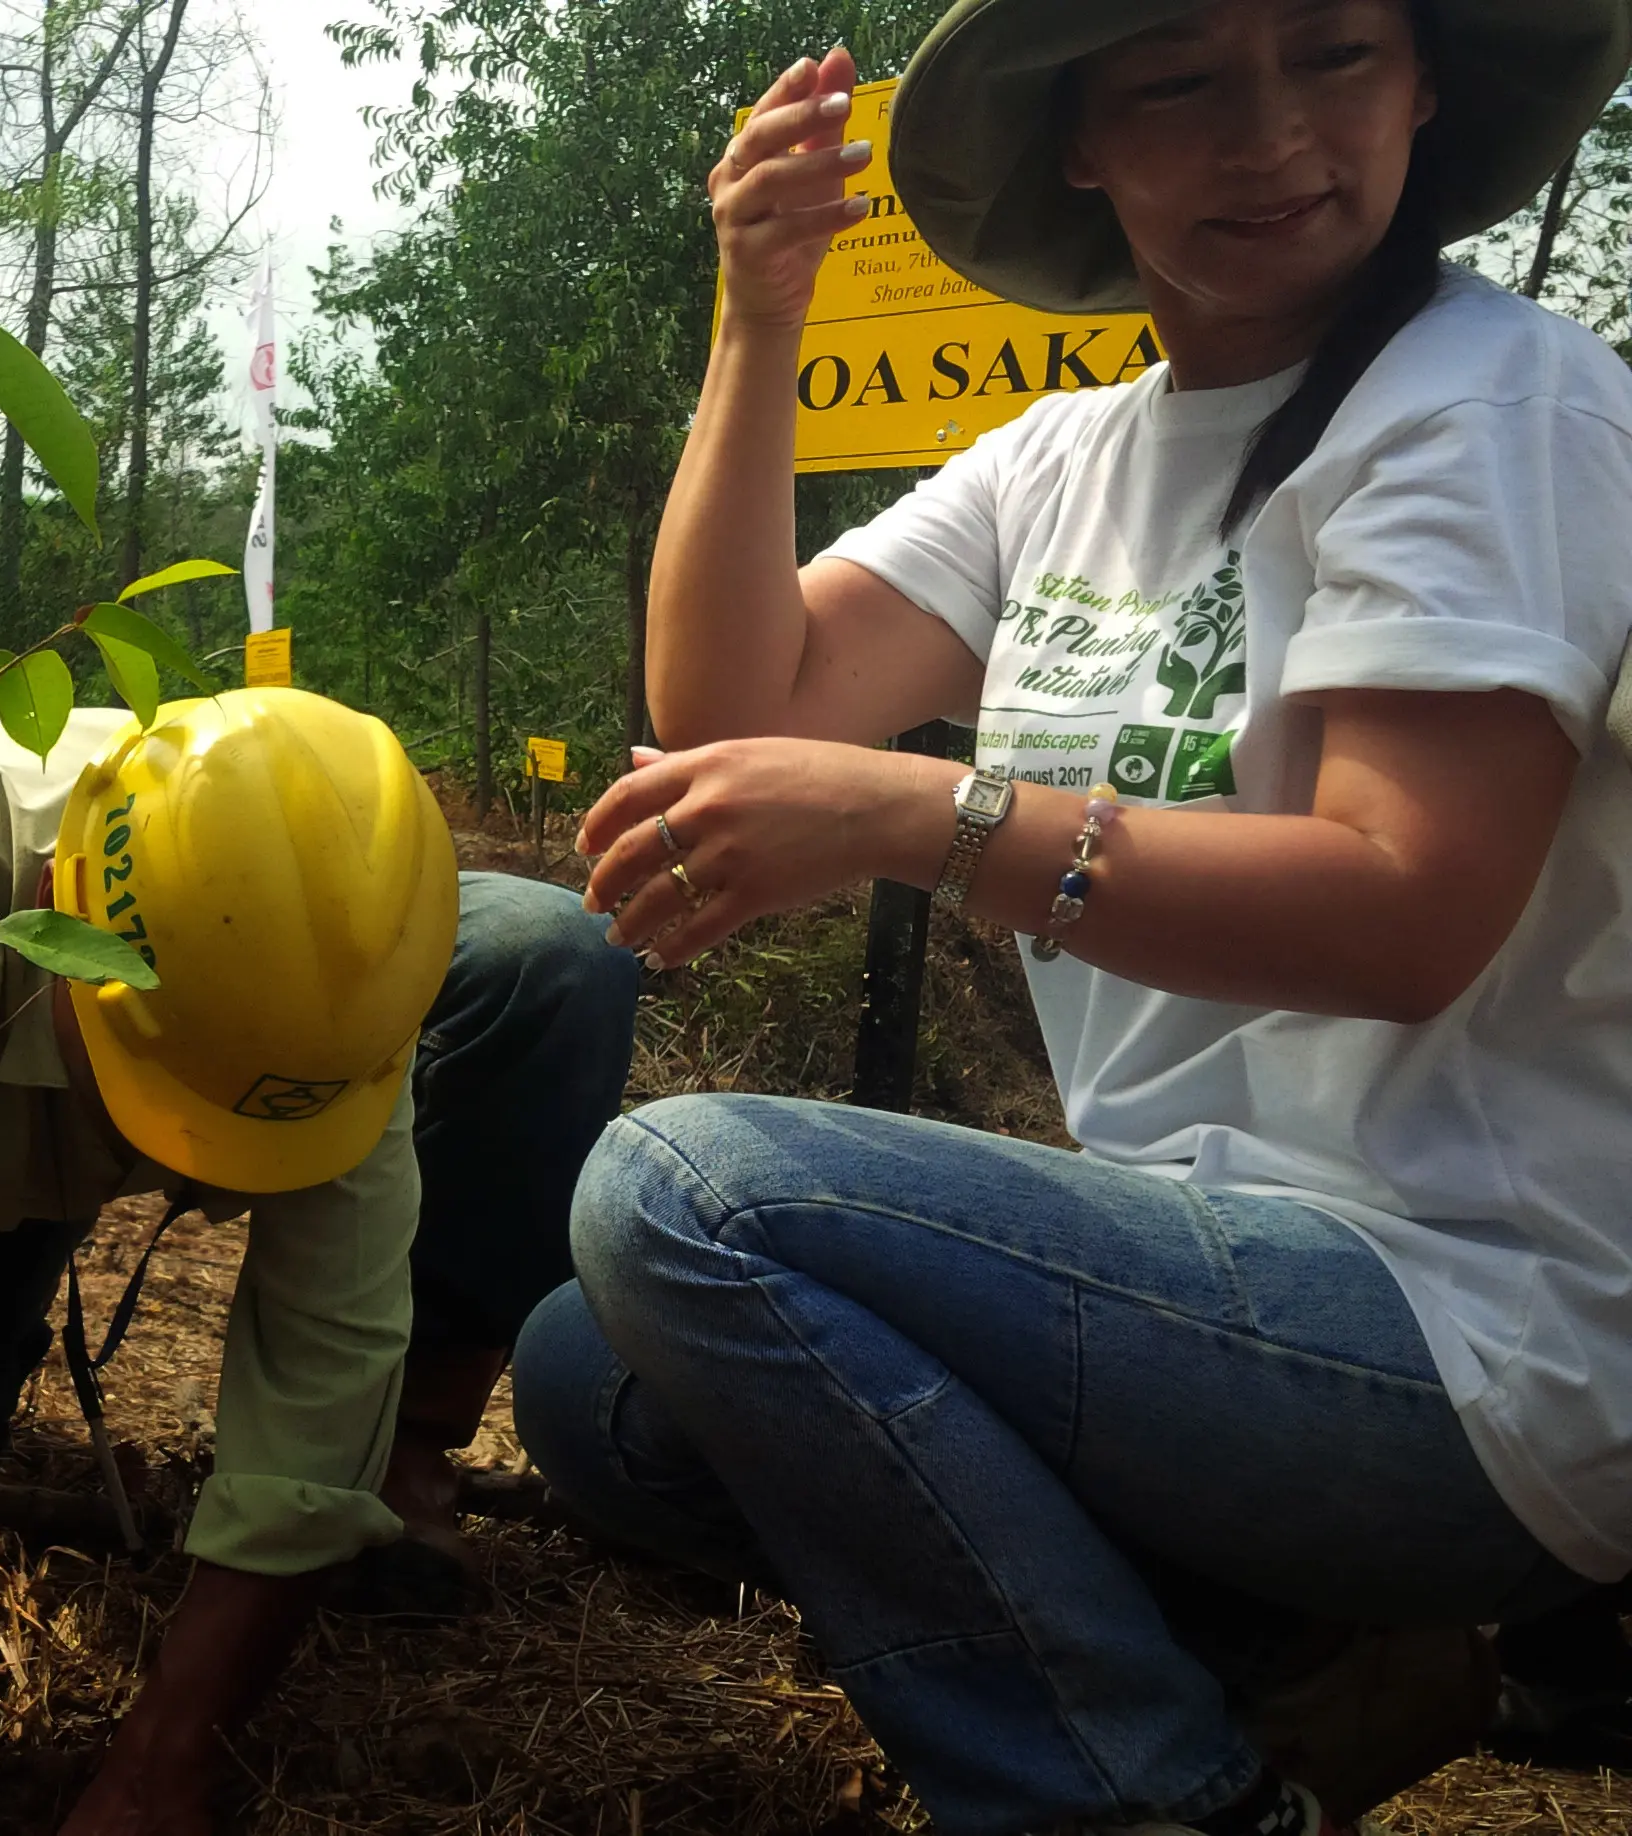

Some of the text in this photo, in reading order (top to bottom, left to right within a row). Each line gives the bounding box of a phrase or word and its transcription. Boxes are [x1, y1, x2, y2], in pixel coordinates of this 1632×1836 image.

[828, 229, 924, 252] erumu
[853, 258, 901, 277] Riau,
[871, 283, 934, 304] Shorea
[928, 323, 1162, 402] SAKA
[1011, 728, 1099, 755] Landscapes
[1008, 766, 1055, 787] August
[1058, 766, 1092, 787] 2017
